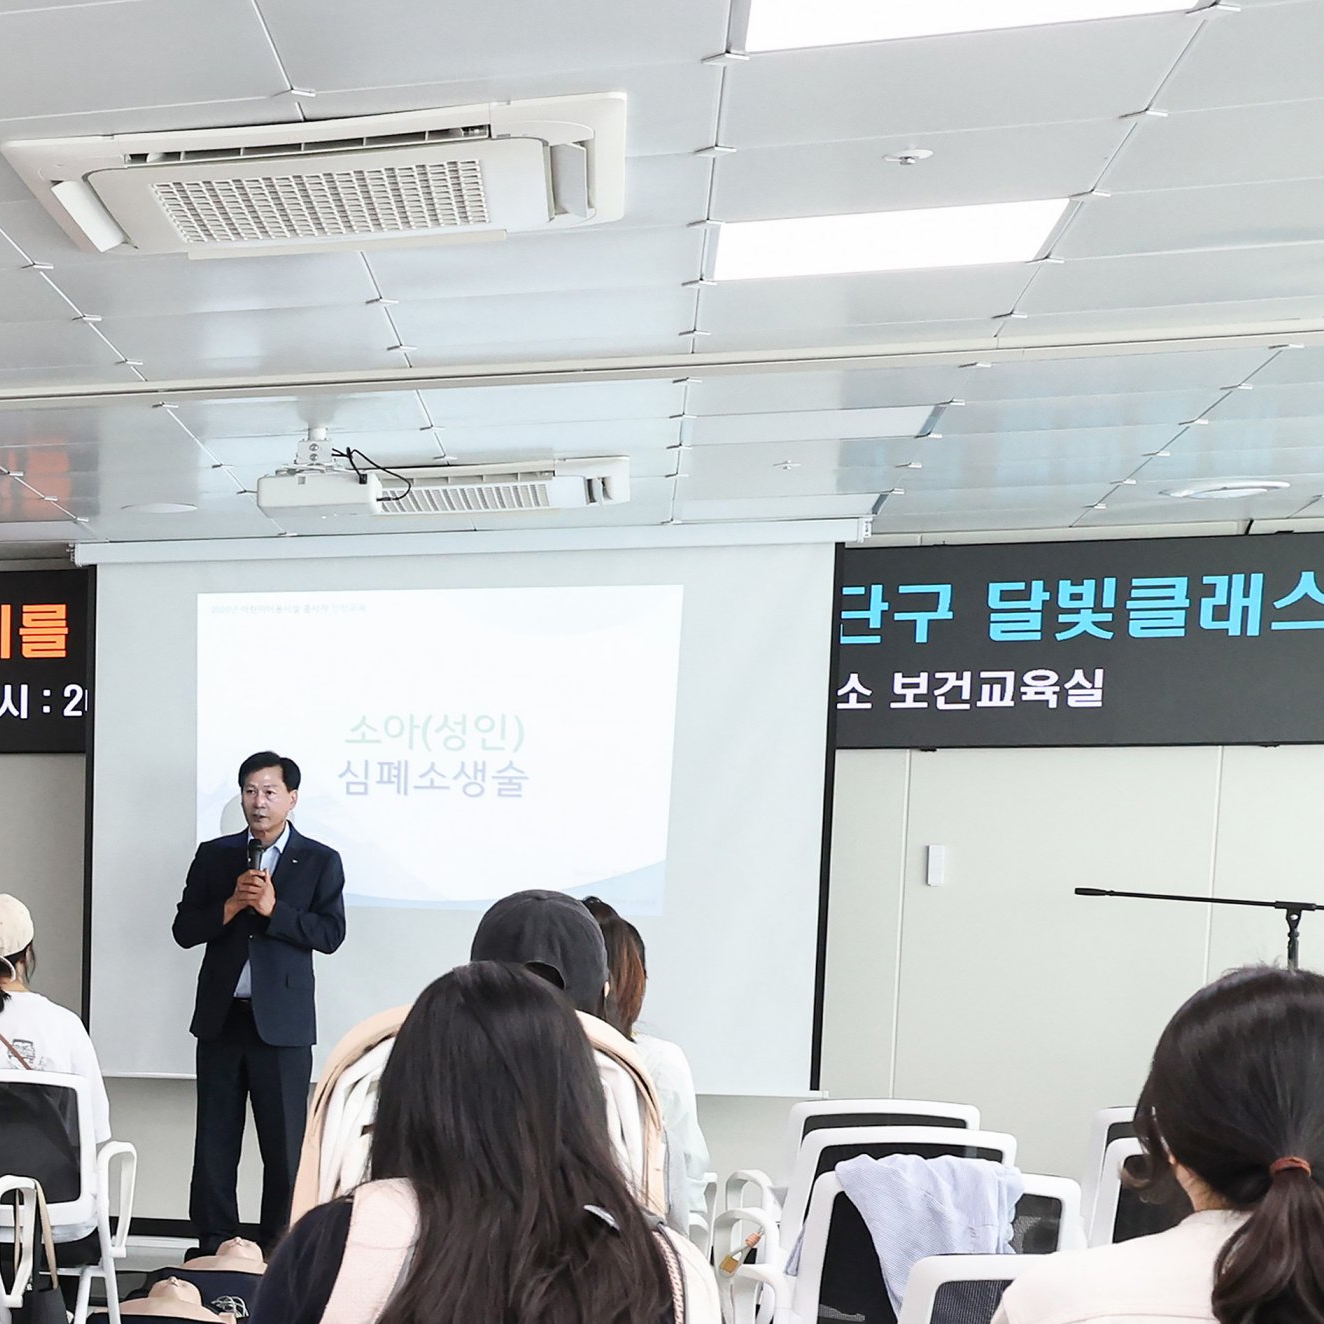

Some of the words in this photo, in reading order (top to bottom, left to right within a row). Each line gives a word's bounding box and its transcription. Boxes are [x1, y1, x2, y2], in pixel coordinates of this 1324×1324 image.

[986, 570, 1324, 643] 달빛클래스
[63, 684, 88, 717] 2
[836, 673, 872, 709] 소
[889, 668, 1104, 710] 보건교육실
[345, 713, 524, 753] 소아(성인)
[338, 759, 529, 798] 심폐소생술
